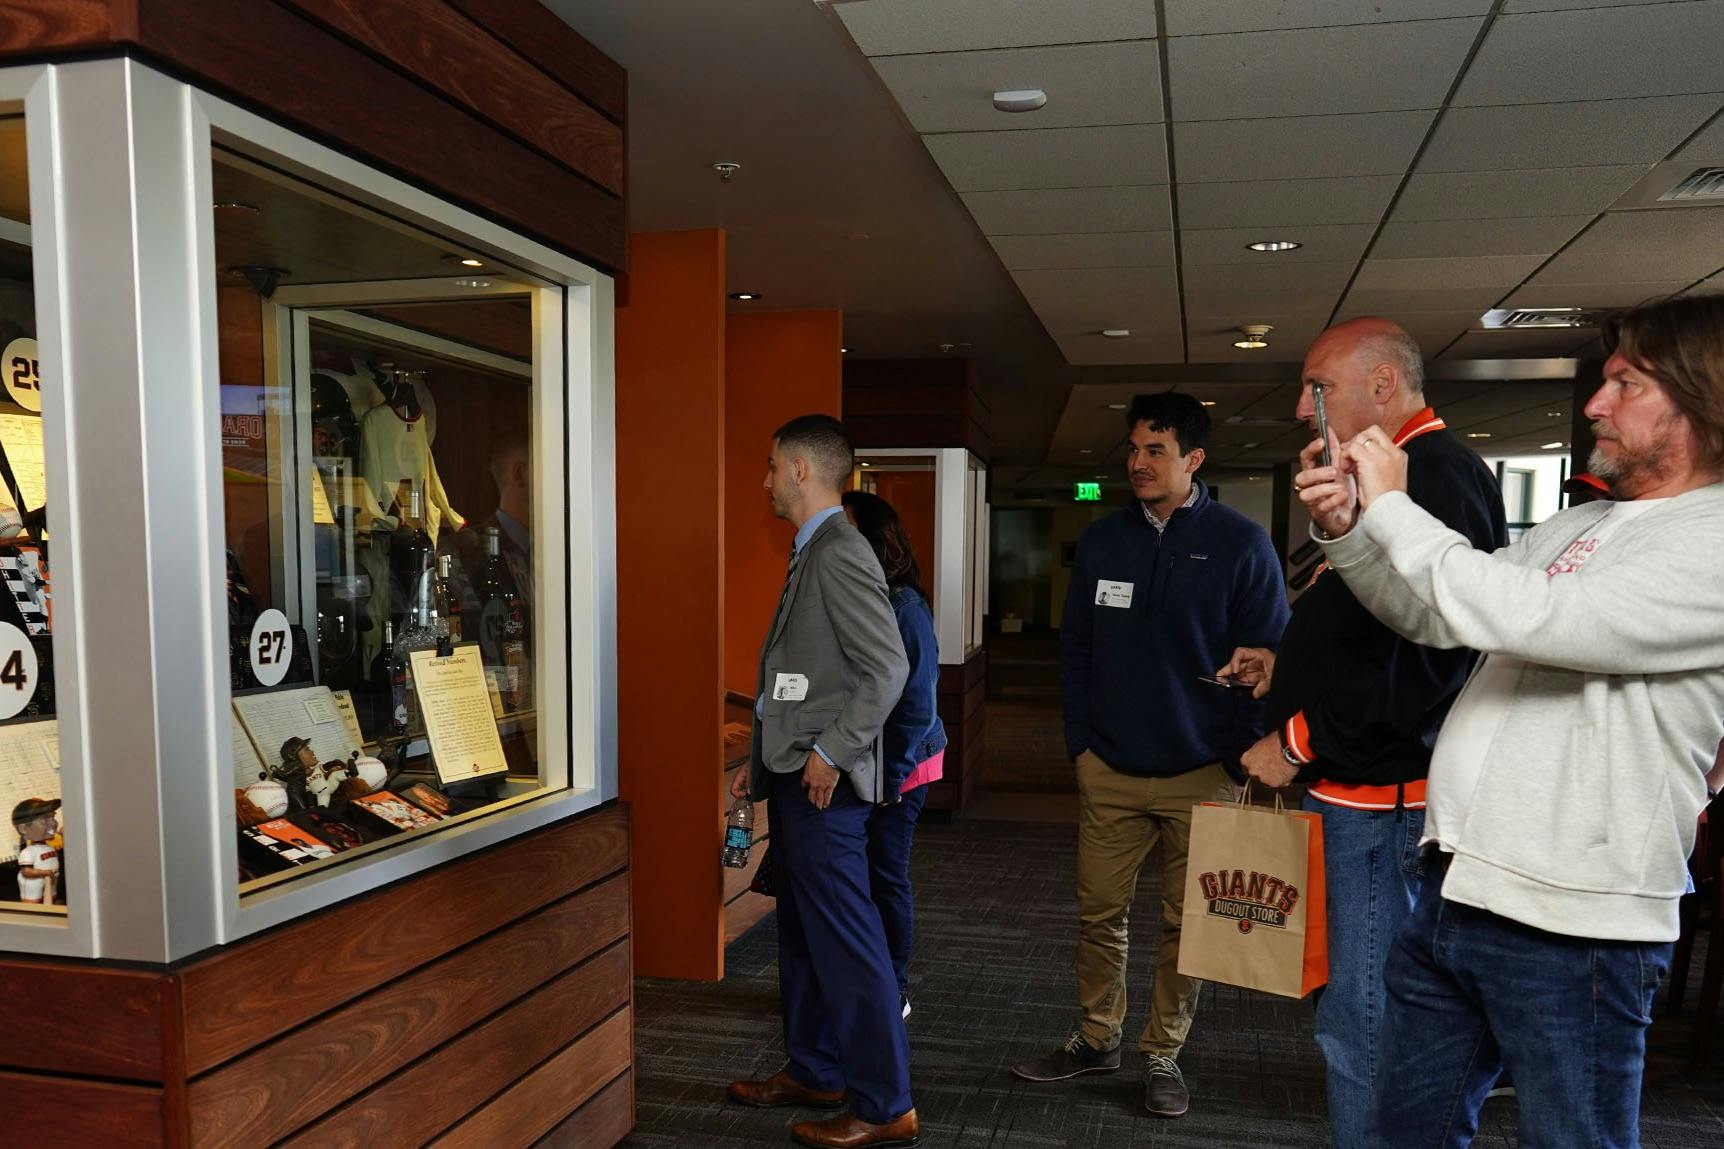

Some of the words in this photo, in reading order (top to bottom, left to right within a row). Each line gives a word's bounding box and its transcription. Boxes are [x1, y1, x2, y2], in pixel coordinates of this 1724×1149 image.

[1077, 482, 1100, 499] EXIT
[259, 630, 285, 665] 27
[1199, 869, 1300, 915] GIANTS
[1214, 900, 1251, 918] DUGOUT
[1251, 906, 1280, 923] STORE
